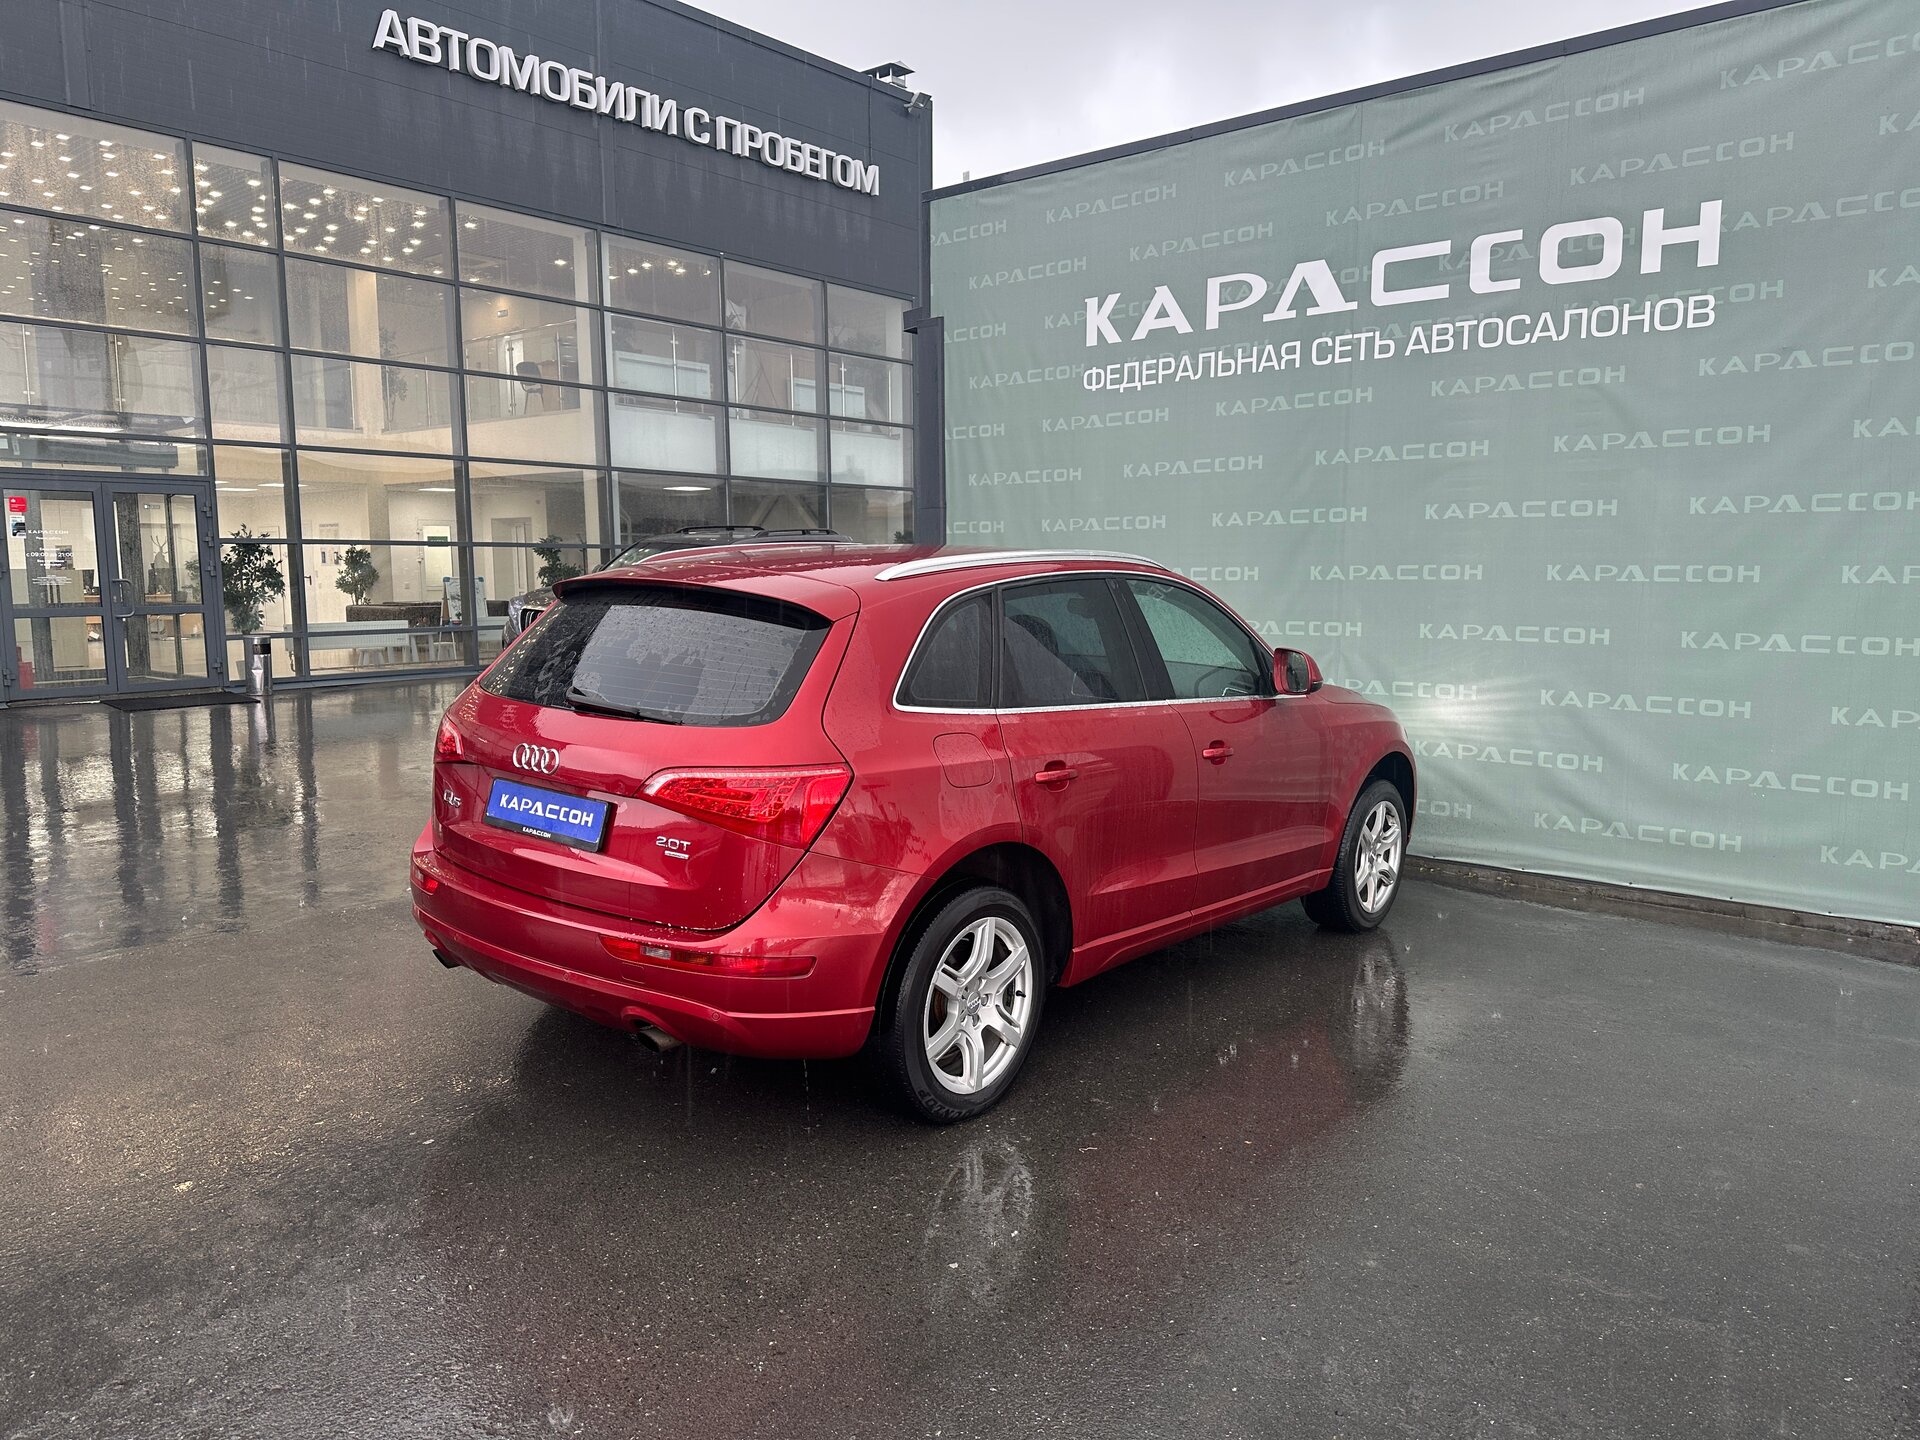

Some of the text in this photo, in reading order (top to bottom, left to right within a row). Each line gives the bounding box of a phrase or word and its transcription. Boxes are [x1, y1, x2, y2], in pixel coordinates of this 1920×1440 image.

[372, 8, 881, 197] АВТОМОБИЛИ С ПРОБЕГОМ
[1082, 295, 1717, 393] ФЕДЕРАЛЬНАЯ СЕТЬ АВТОСАЛОНОВ
[655, 835, 691, 851] 2.0T
